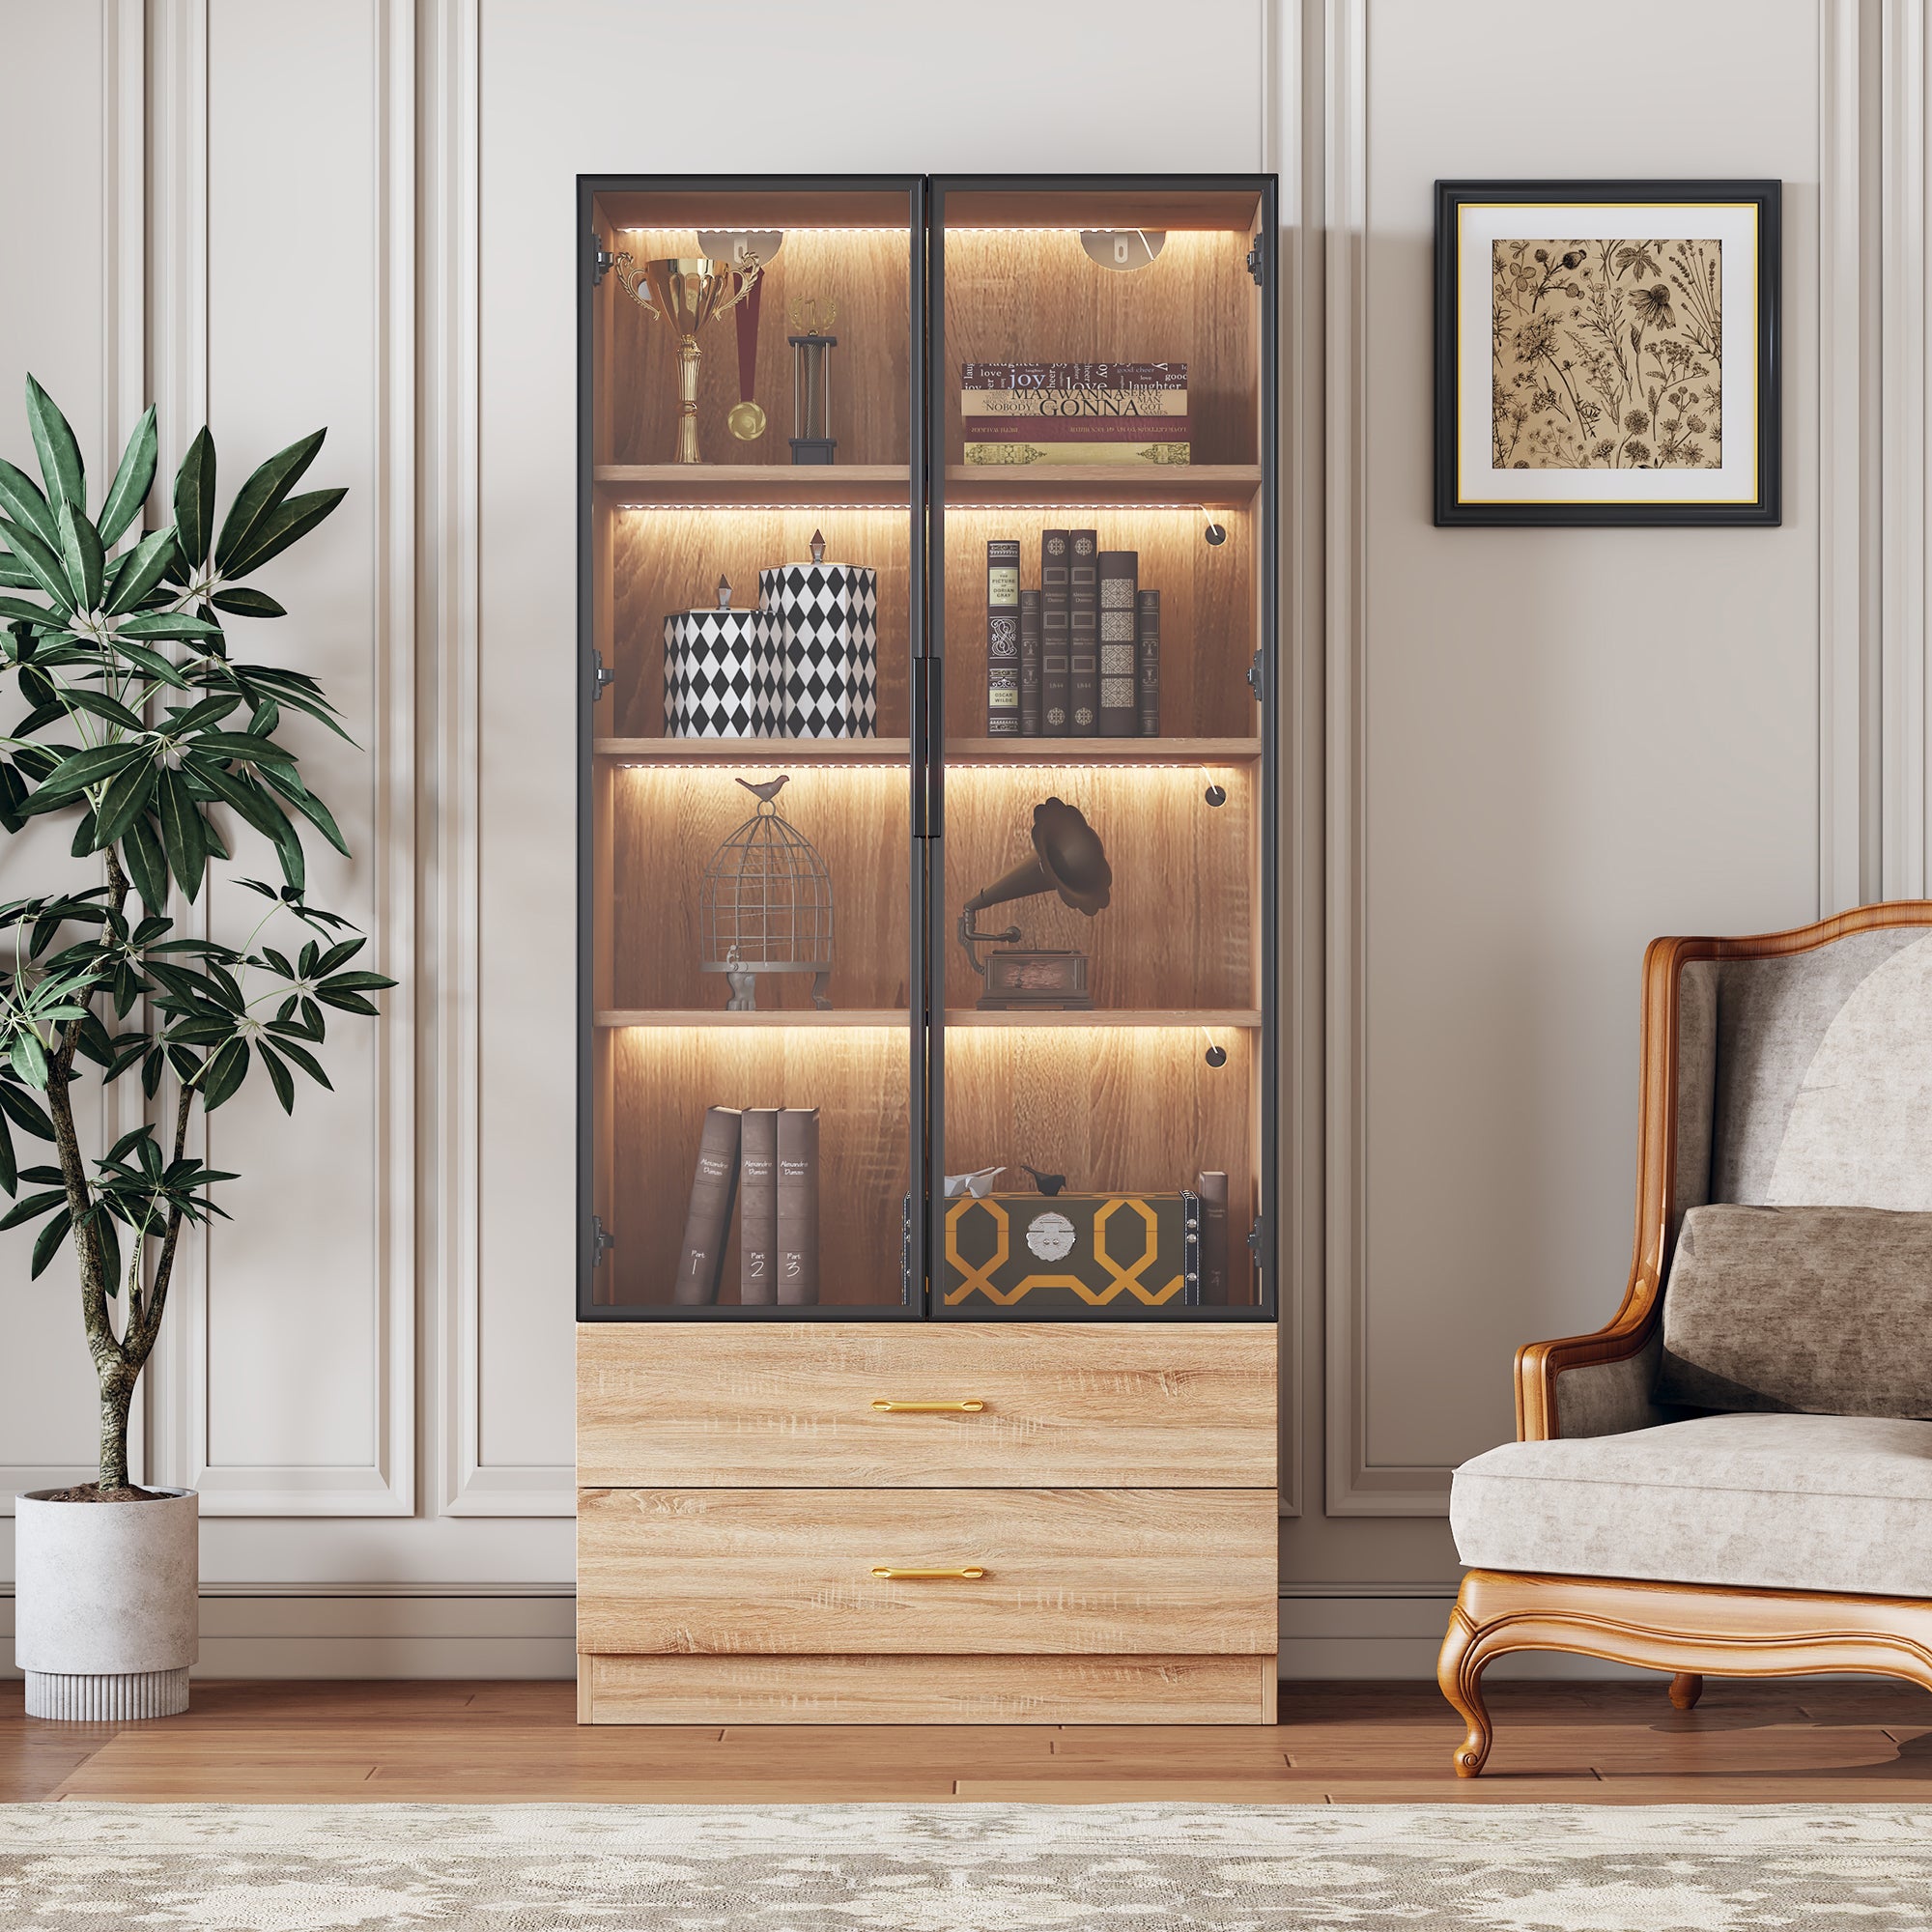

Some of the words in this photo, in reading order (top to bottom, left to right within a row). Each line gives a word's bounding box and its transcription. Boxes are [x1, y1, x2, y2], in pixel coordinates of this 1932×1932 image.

[980, 368, 1002, 377] love
[1008, 369, 1046, 390] joy
[1065, 376, 1108, 390] love
[1129, 381, 1182, 390] laughter
[1011, 388, 1054, 400] MAY
[1058, 388, 1124, 400] WANNA
[1123, 388, 1162, 397] SERVE
[986, 403, 1033, 412] NOBODY
[1039, 398, 1141, 416] GONNA
[691, 1249, 705, 1259] Part
[692, 1259, 697, 1275] 1
[751, 1261, 764, 1277] 2
[785, 1261, 801, 1278] 3
